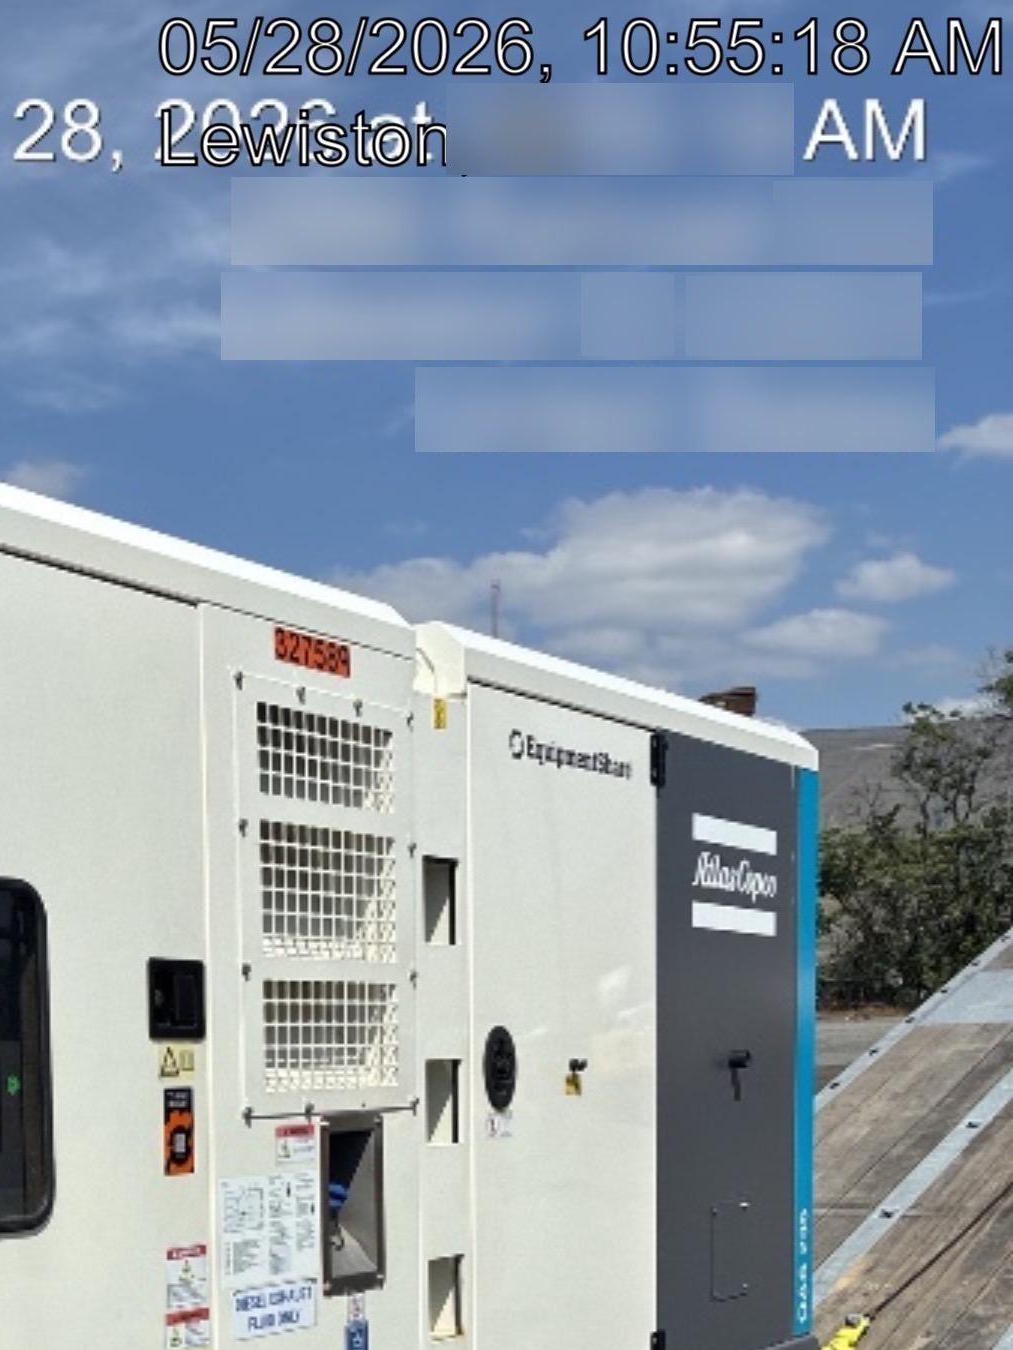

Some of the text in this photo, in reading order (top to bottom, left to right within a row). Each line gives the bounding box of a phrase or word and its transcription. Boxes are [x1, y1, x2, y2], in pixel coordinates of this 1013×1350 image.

[275, 626, 351, 678] 327589
[692, 850, 778, 904] Atlas Copco
